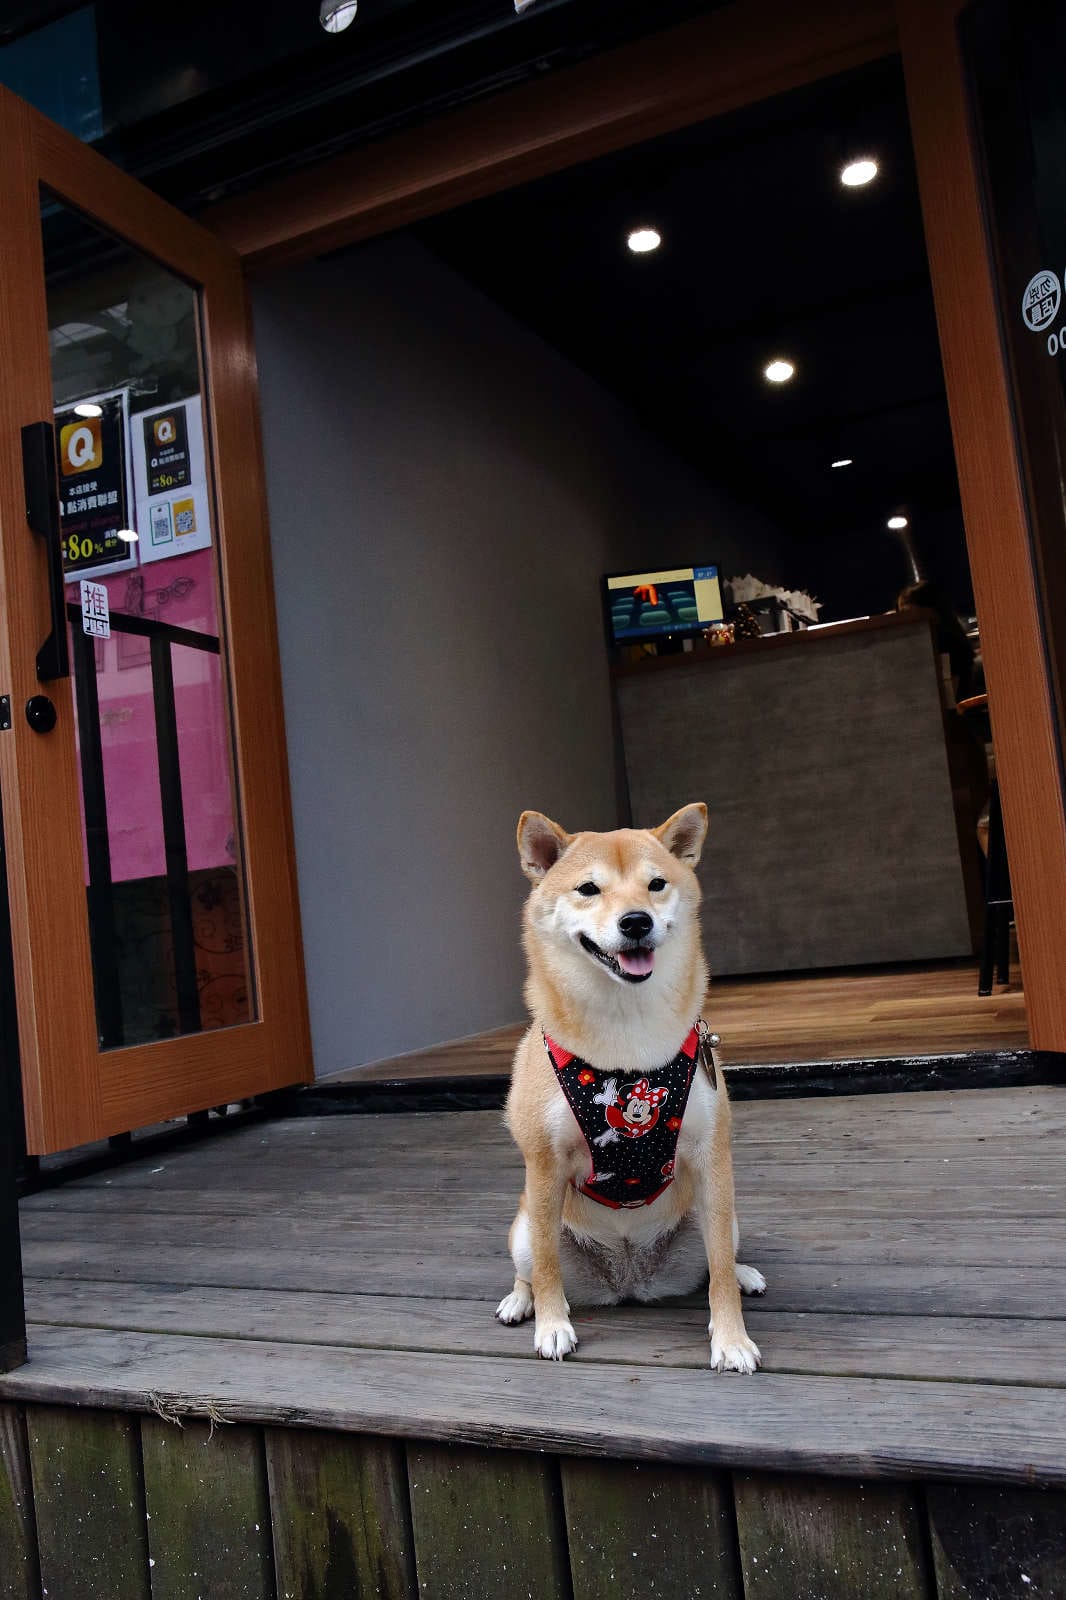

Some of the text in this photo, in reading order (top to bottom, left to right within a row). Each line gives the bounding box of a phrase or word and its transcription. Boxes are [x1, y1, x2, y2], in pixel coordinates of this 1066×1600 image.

[67, 427, 96, 467] Q
[157, 421, 173, 442] Q
[83, 584, 106, 616] 推
